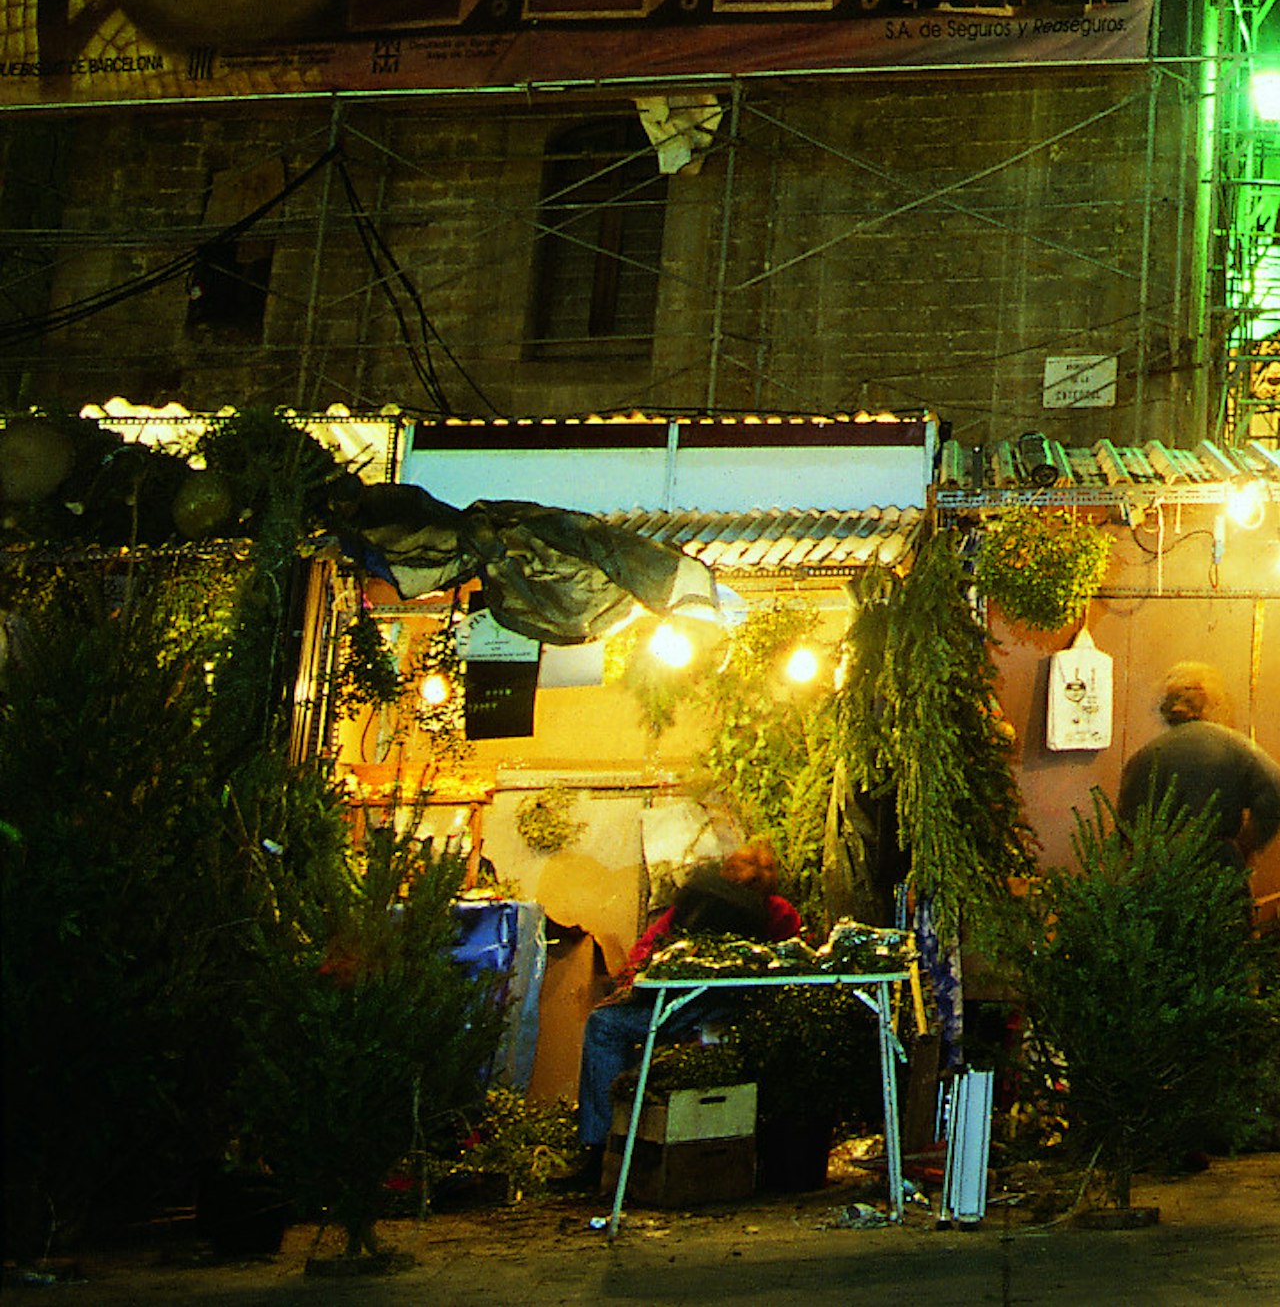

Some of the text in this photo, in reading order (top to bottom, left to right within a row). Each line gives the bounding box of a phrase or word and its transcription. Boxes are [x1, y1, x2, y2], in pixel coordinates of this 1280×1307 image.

[919, 20, 942, 38] de
[947, 20, 1011, 41] Seguros
[1018, 21, 1028, 39] y
[89, 55, 164, 74] BARCELONA
